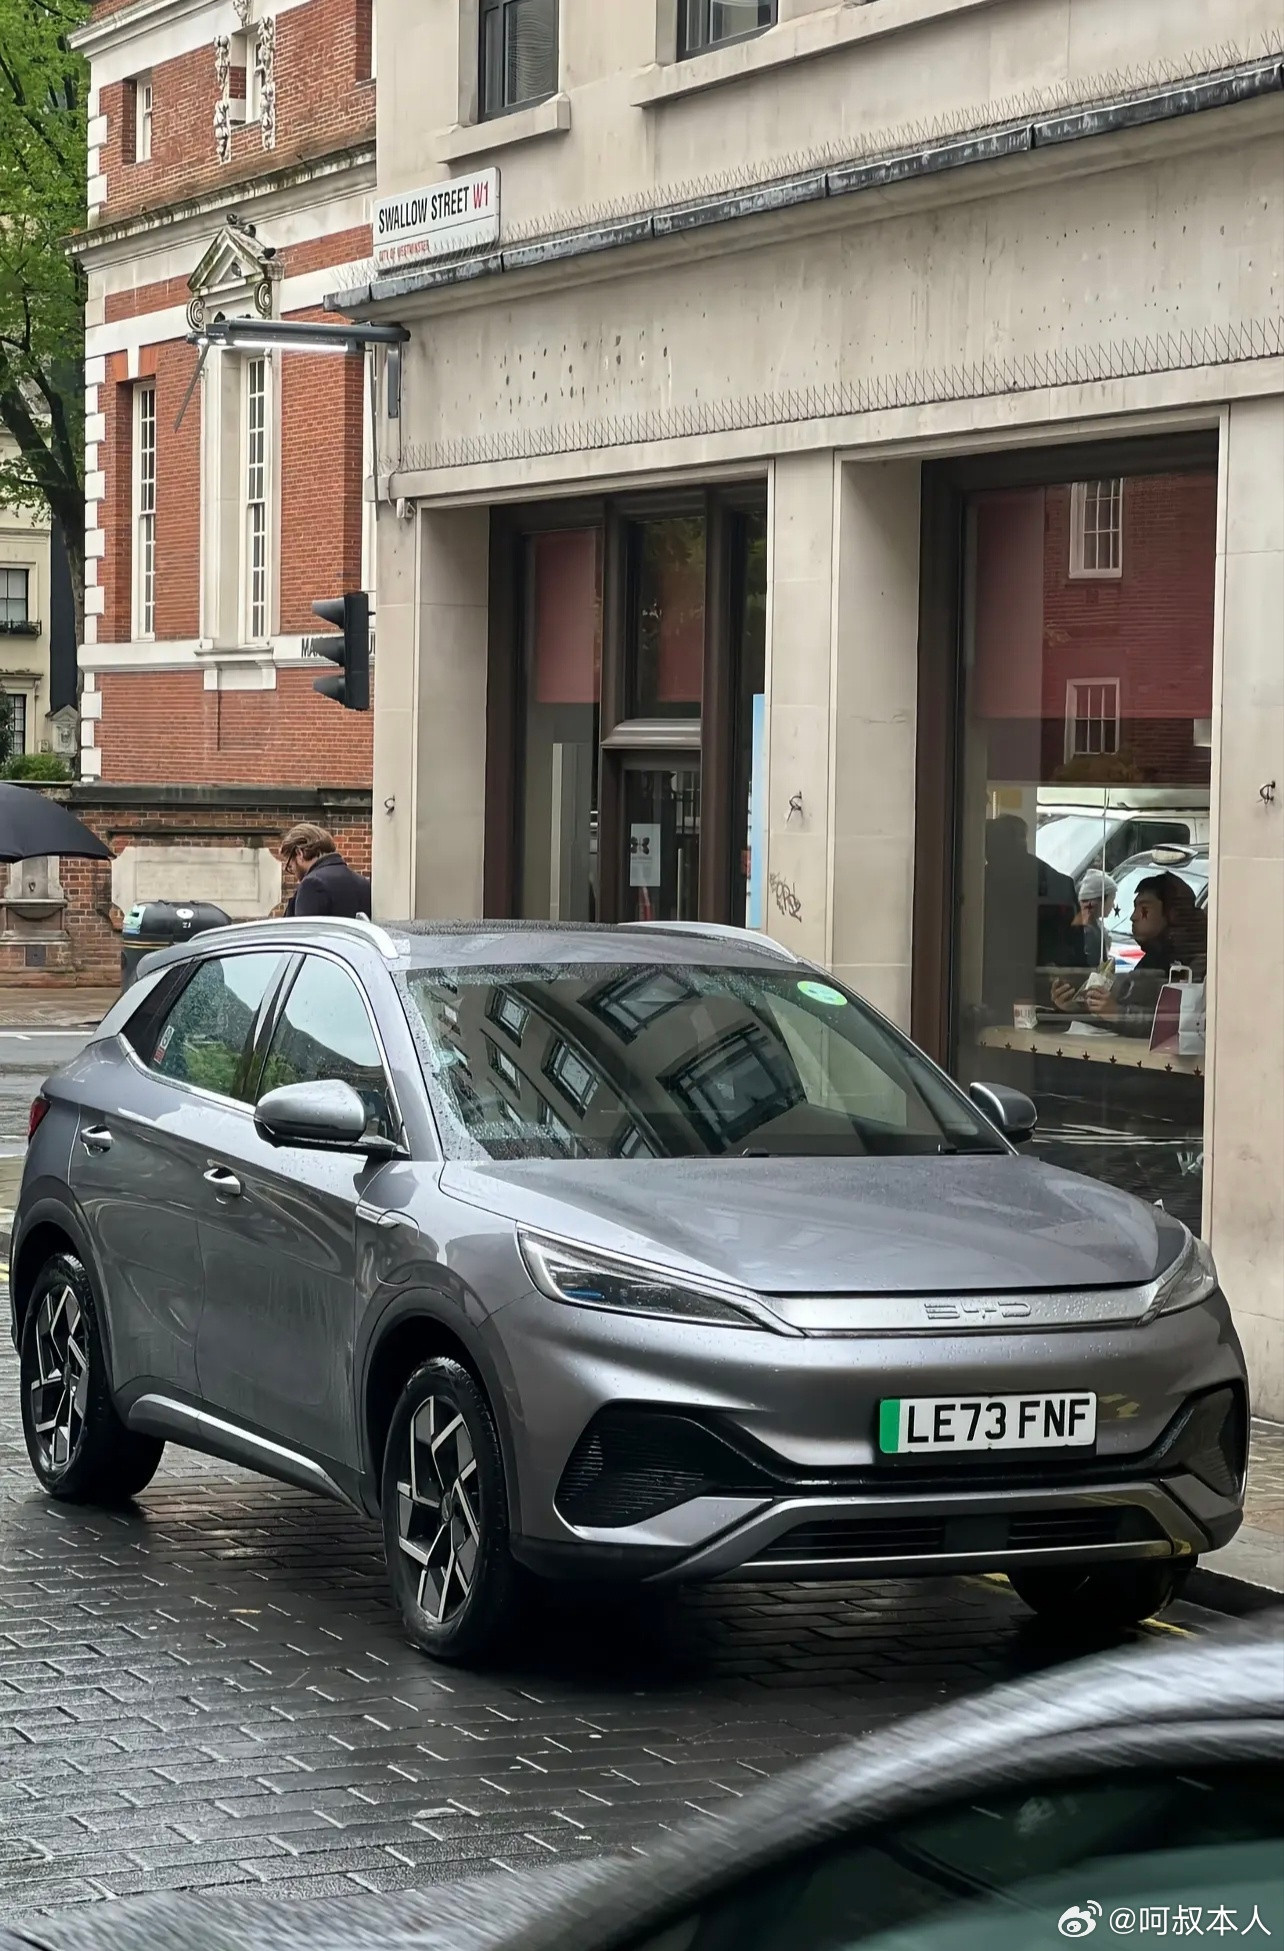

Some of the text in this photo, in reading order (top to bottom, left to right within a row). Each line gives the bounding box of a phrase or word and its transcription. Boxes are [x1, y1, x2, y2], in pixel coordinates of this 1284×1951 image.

[379, 181, 489, 234] SWALLOW STREET W1
[924, 1299, 1032, 1320] BYD
[907, 1398, 1091, 1443] LE73 FNF
